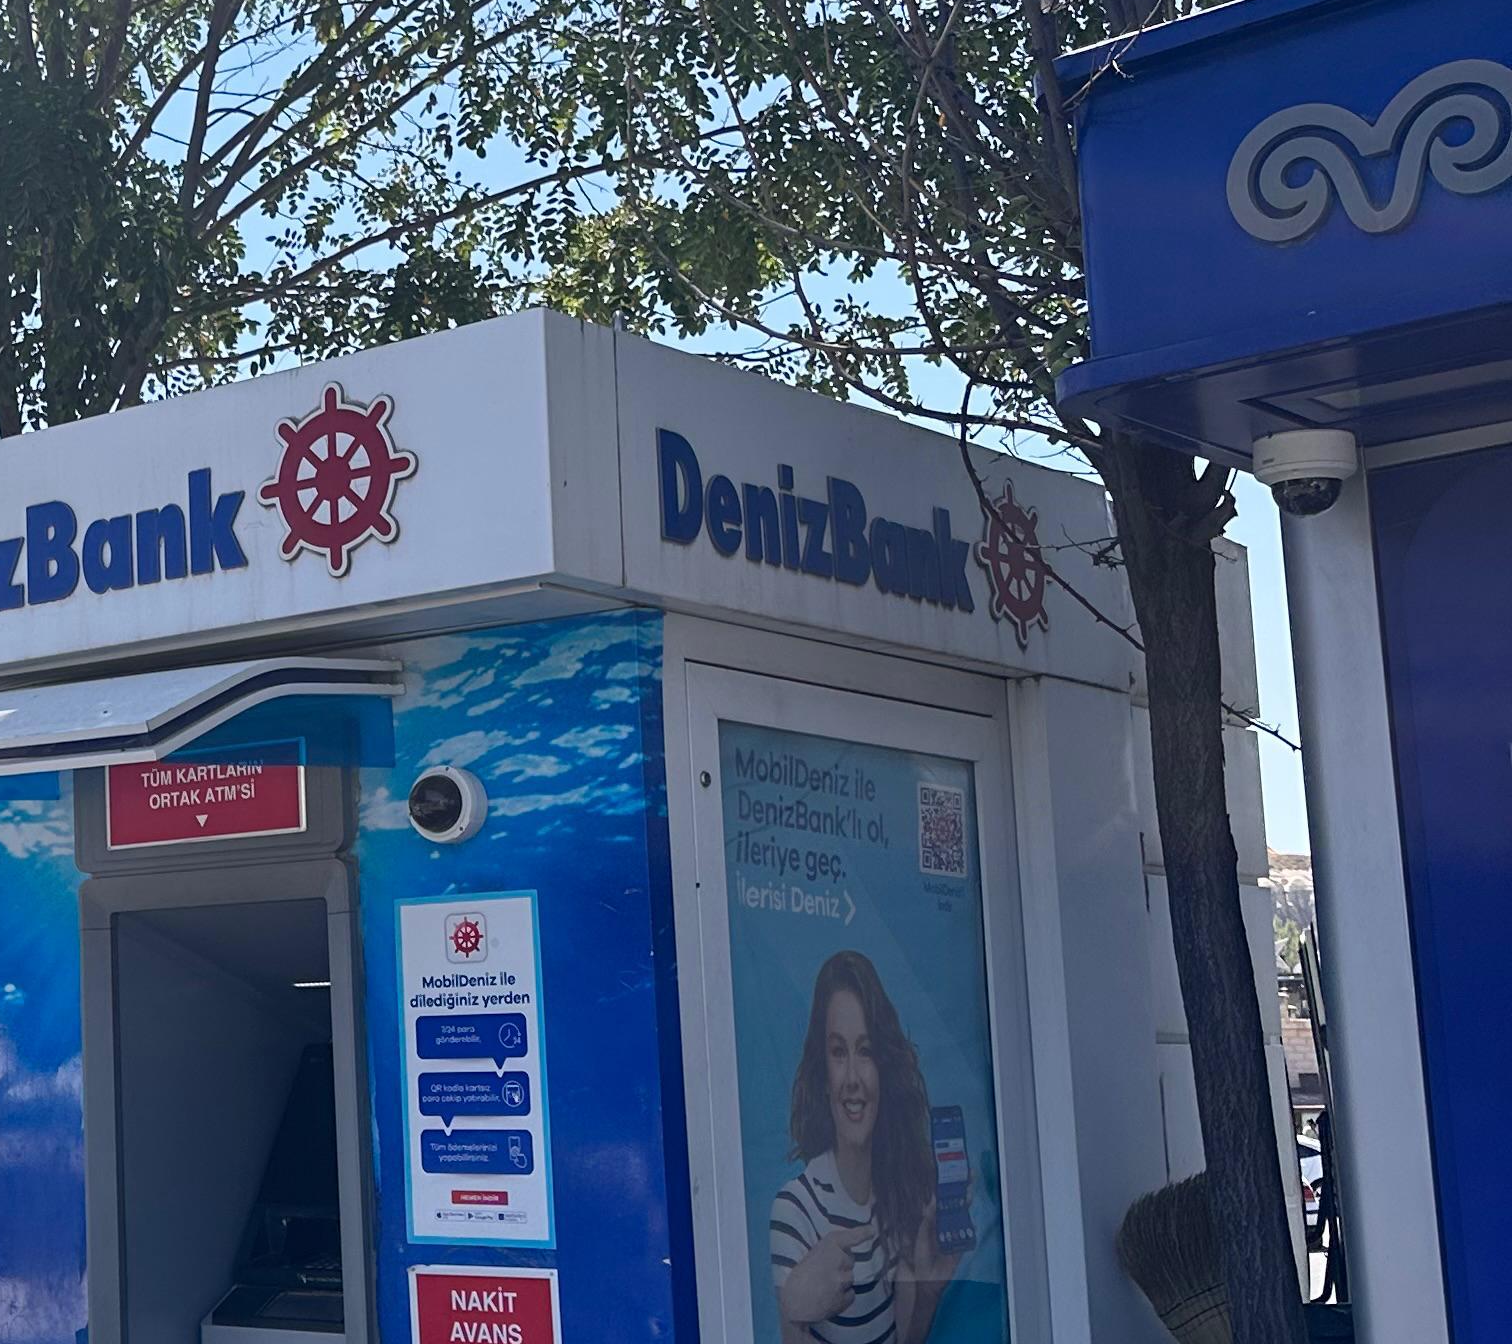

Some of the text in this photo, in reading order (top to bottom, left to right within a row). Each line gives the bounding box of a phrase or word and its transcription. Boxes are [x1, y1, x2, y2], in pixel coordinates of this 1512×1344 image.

[655, 427, 974, 613] DenizBank
[141, 760, 264, 788] TÜM KARTLARIN
[736, 748, 876, 802] MobilDeniz ile
[149, 779, 255, 809] ORTAK ATM'Sİ
[737, 789, 888, 849] DenizBank'lı ol,
[736, 830, 847, 883] ileriye geç.
[791, 882, 840, 918] Deniz
[422, 971, 516, 988] MobilDeniz ile
[410, 991, 530, 1010] dilediğiniz yerden
[451, 1286, 517, 1312] NAKİT
